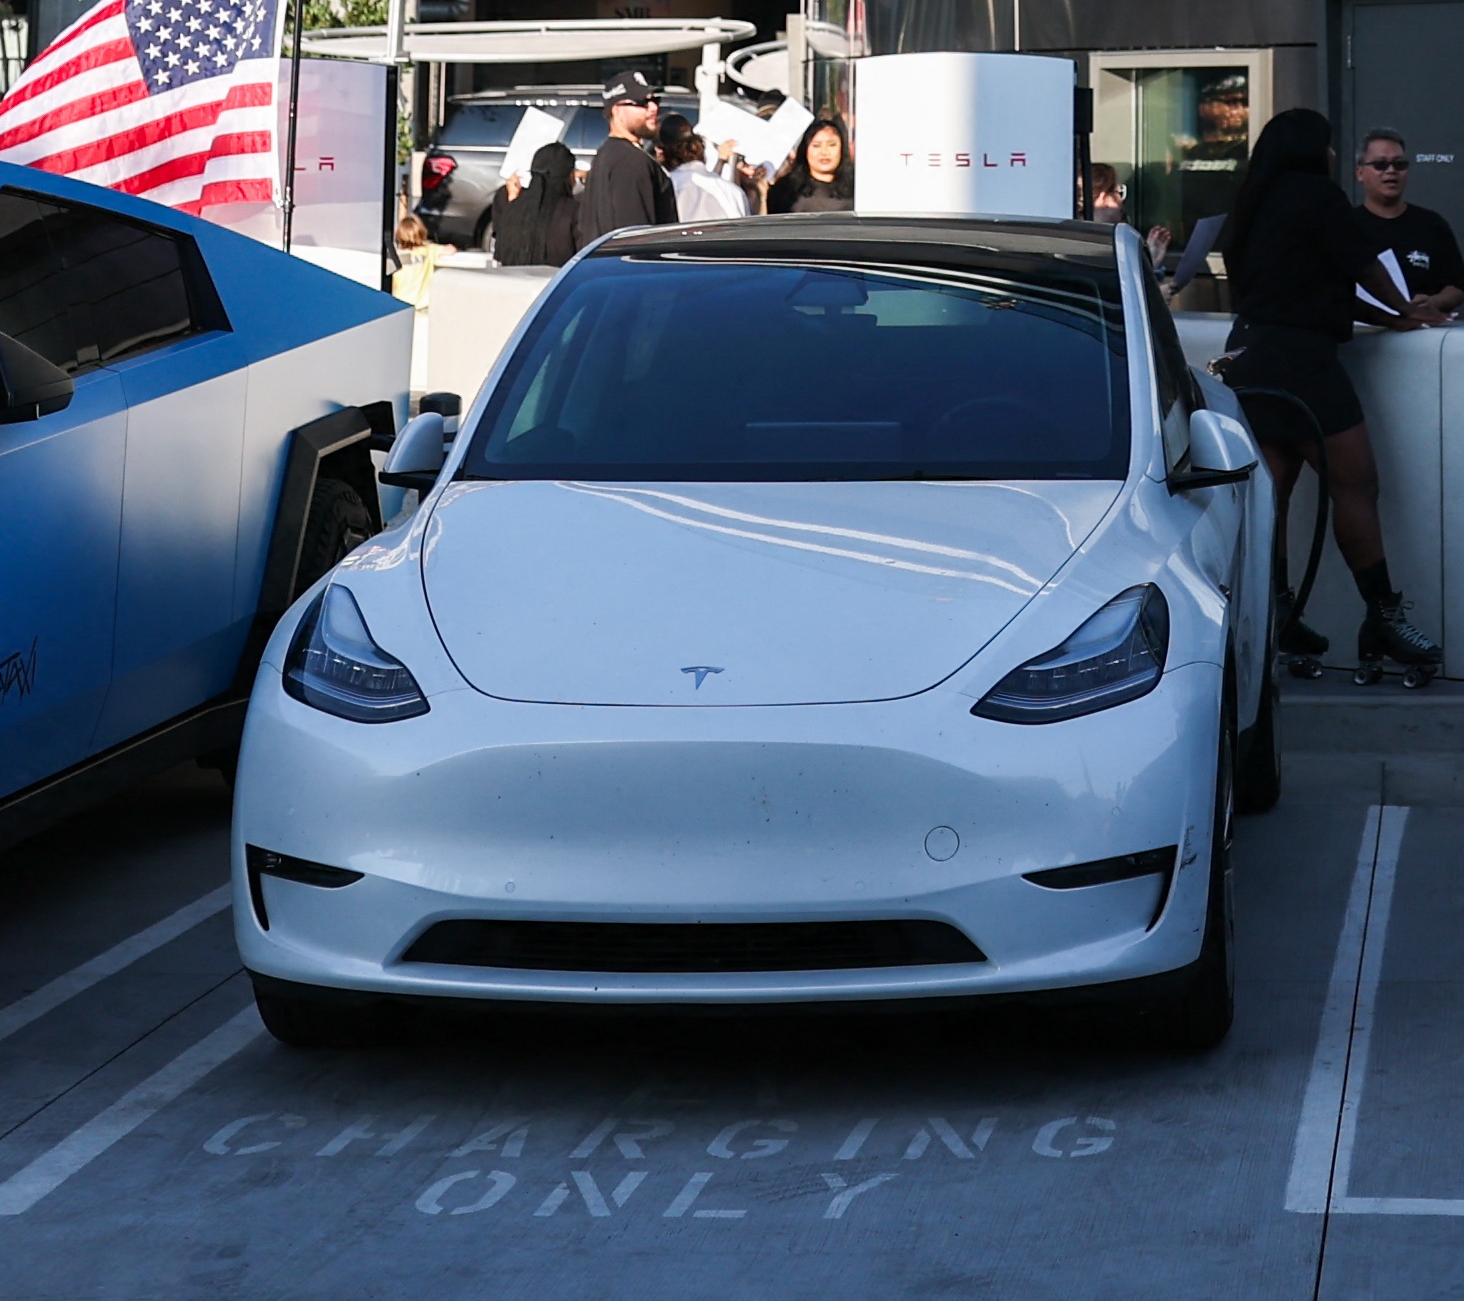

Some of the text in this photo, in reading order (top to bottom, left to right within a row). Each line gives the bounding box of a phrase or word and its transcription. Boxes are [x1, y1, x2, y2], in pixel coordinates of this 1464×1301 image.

[900, 153, 1026, 167] TESLA
[201, 1110, 1119, 1161] CHARGING
[413, 1167, 900, 1220] ONLY
